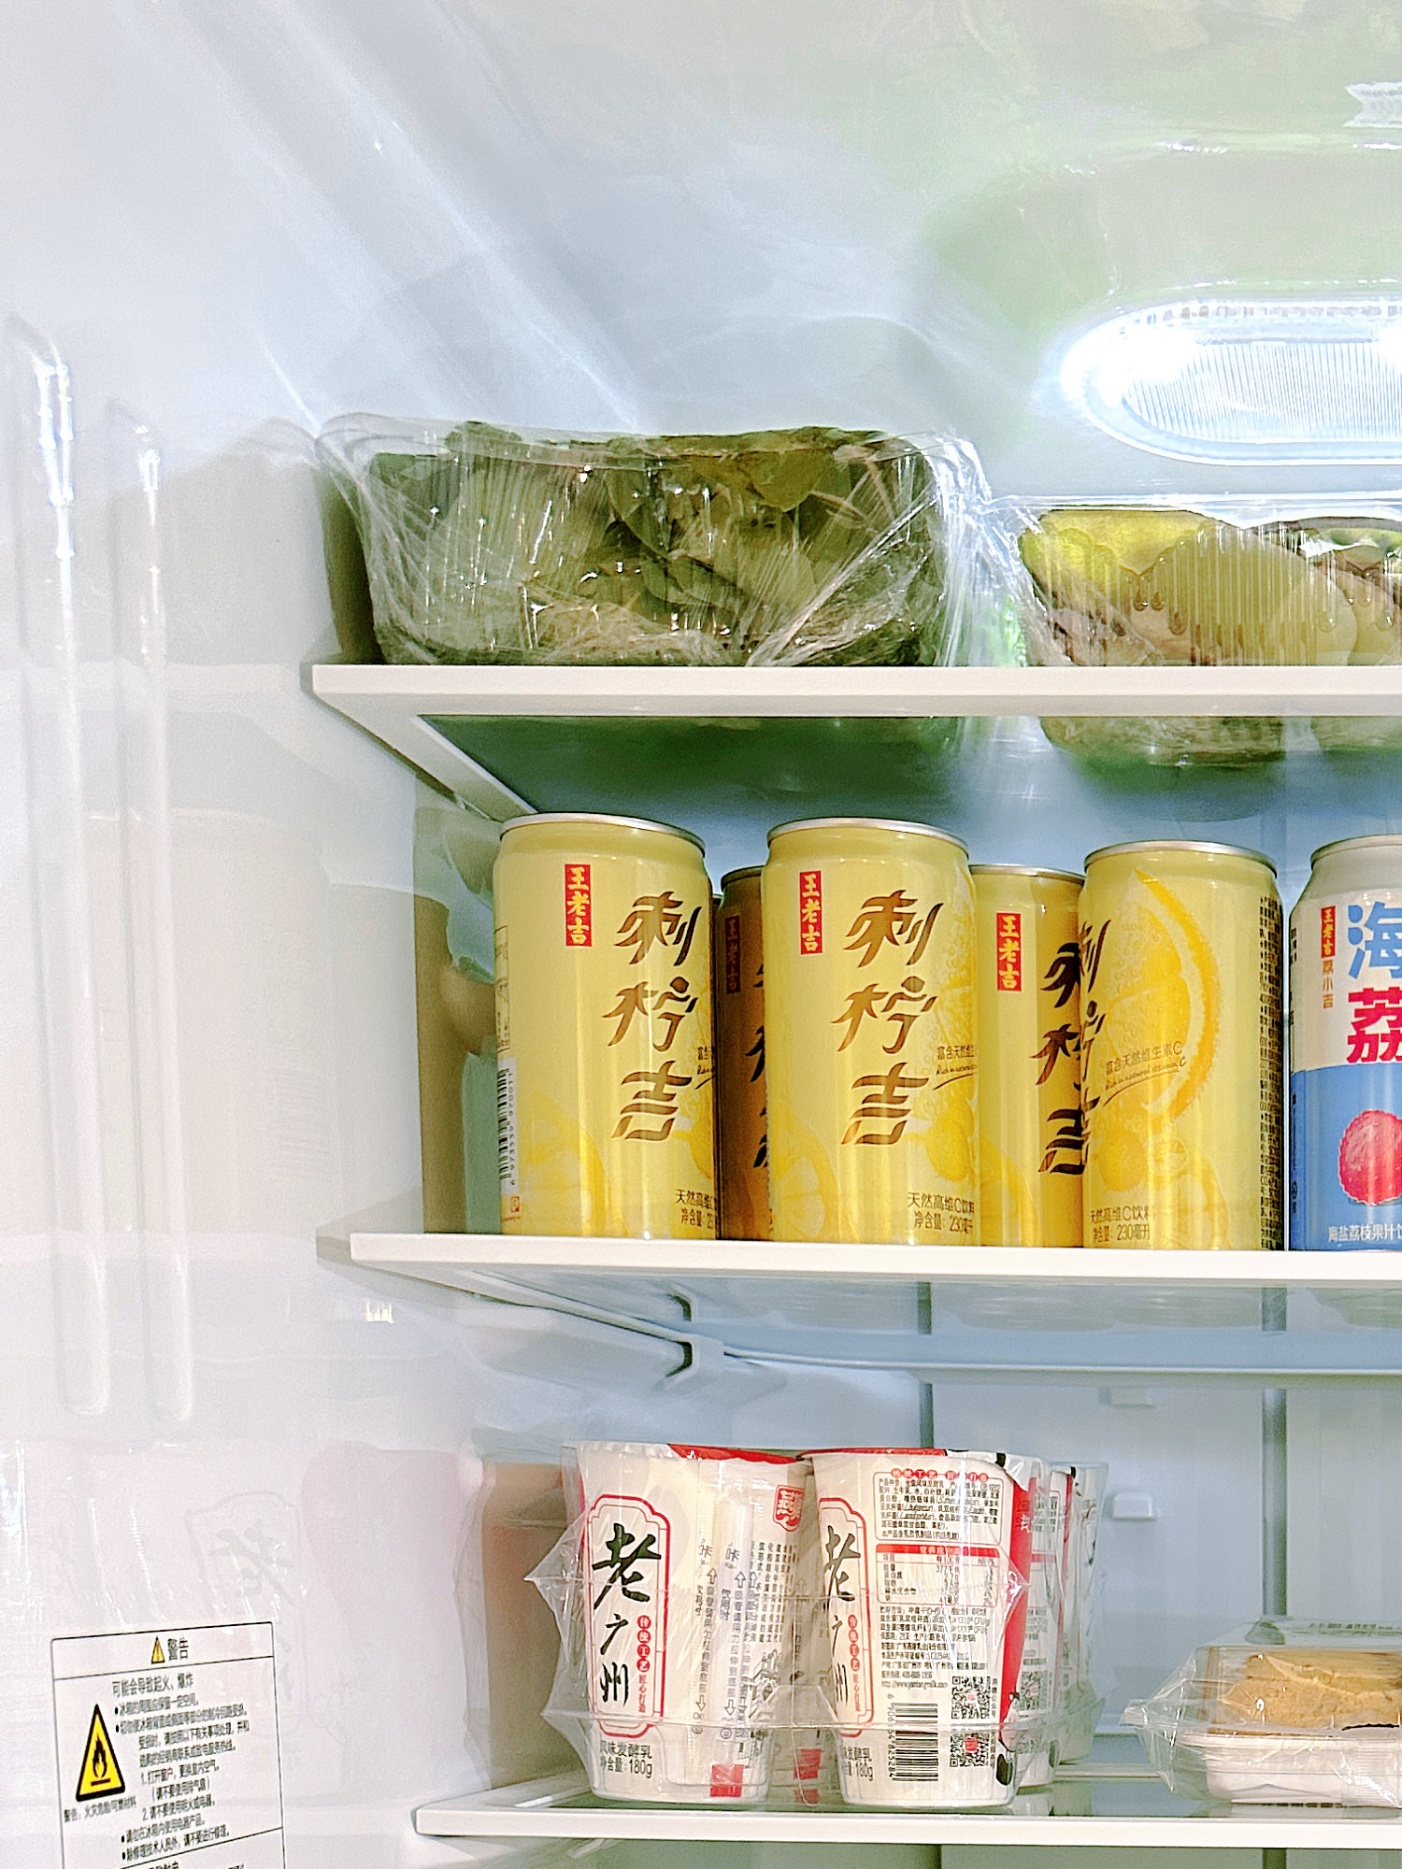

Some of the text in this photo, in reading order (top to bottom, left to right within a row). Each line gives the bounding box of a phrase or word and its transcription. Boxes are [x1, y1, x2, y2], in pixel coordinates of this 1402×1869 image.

[566, 866, 591, 945] 王老吉
[802, 872, 821, 953] 王老吉
[998, 914, 1020, 990] 王老吉
[601, 890, 701, 1142] 刺柠吉
[831, 889, 944, 1146] 刺柠吉
[167, 1637, 189, 1661] 警告
[592, 1523, 662, 1709] 老广州
[111, 1671, 194, 1698] 可能会导致起火、爆炸
